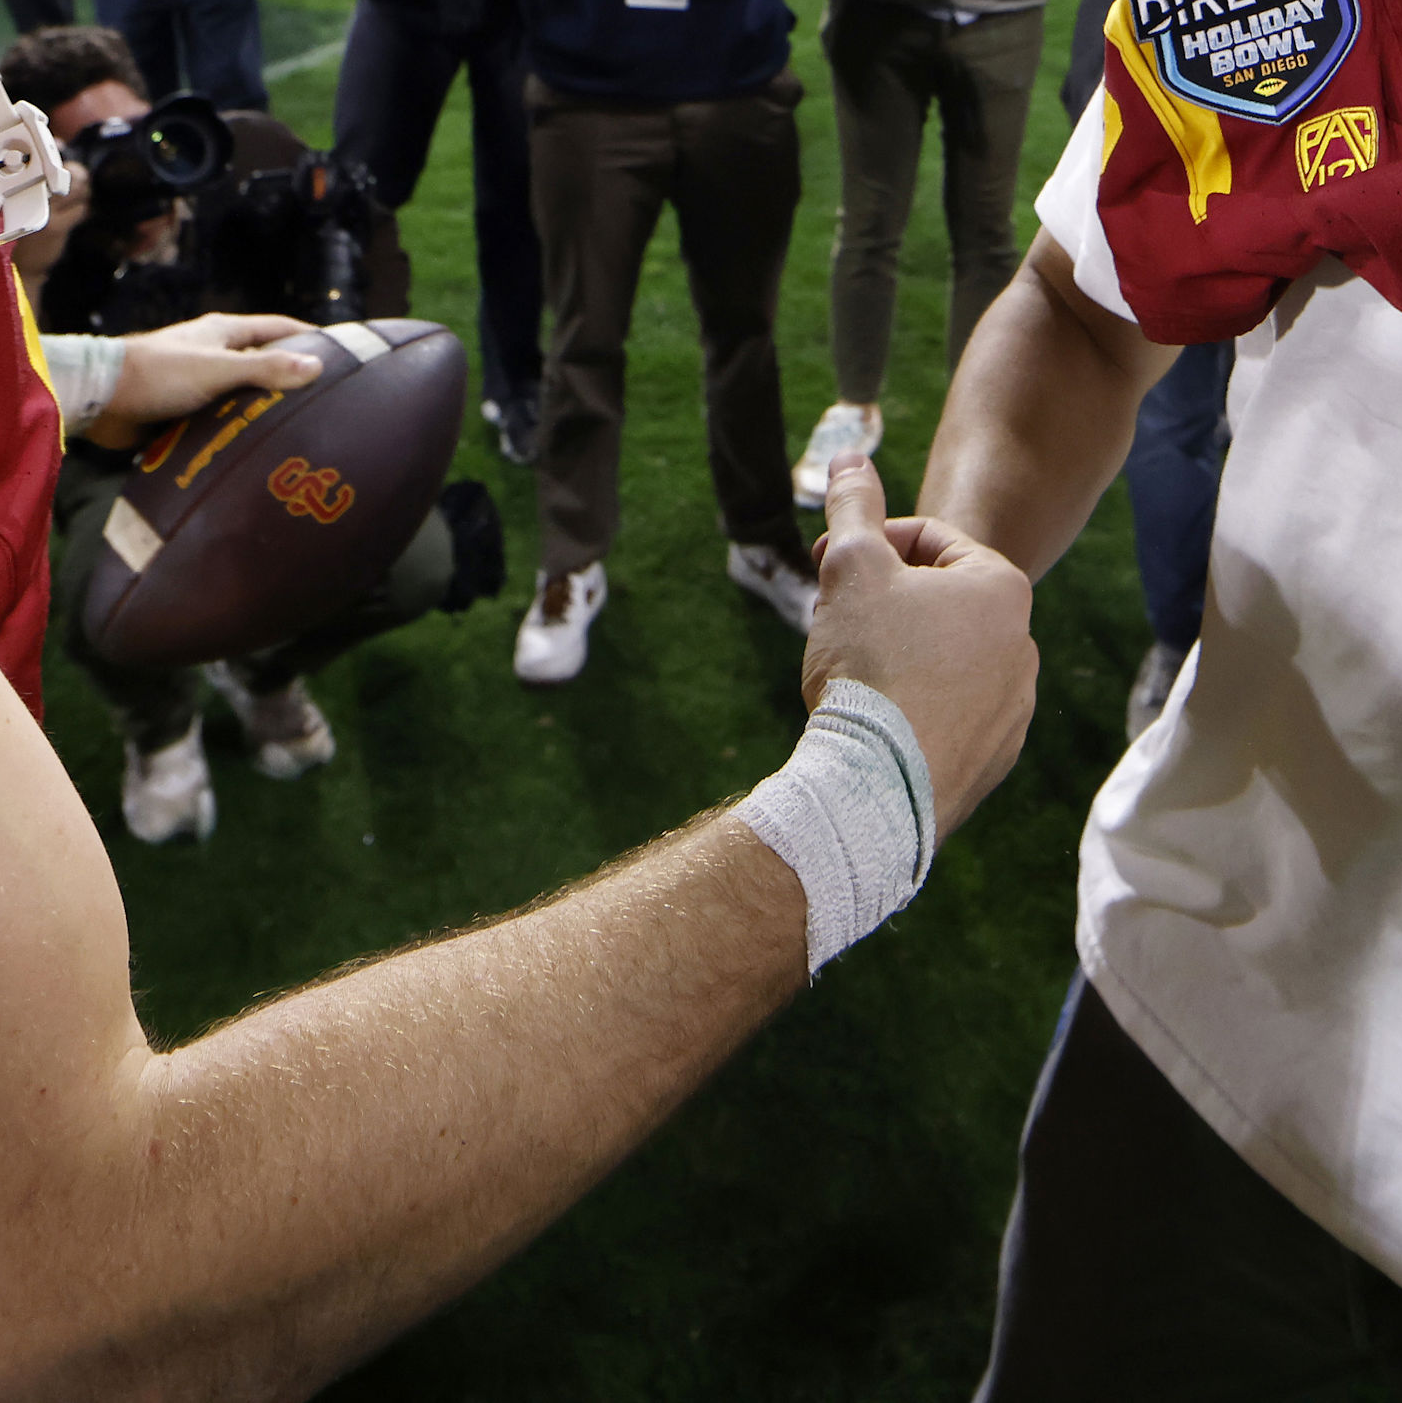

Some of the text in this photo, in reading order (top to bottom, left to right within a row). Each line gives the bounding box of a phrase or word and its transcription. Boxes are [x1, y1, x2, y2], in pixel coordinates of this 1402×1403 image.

[1209, 25, 1316, 78] BOWL
[1222, 52, 1309, 88] SAN DIEGO
[1300, 111, 1372, 188] PAC
[267, 456, 356, 525] SC
